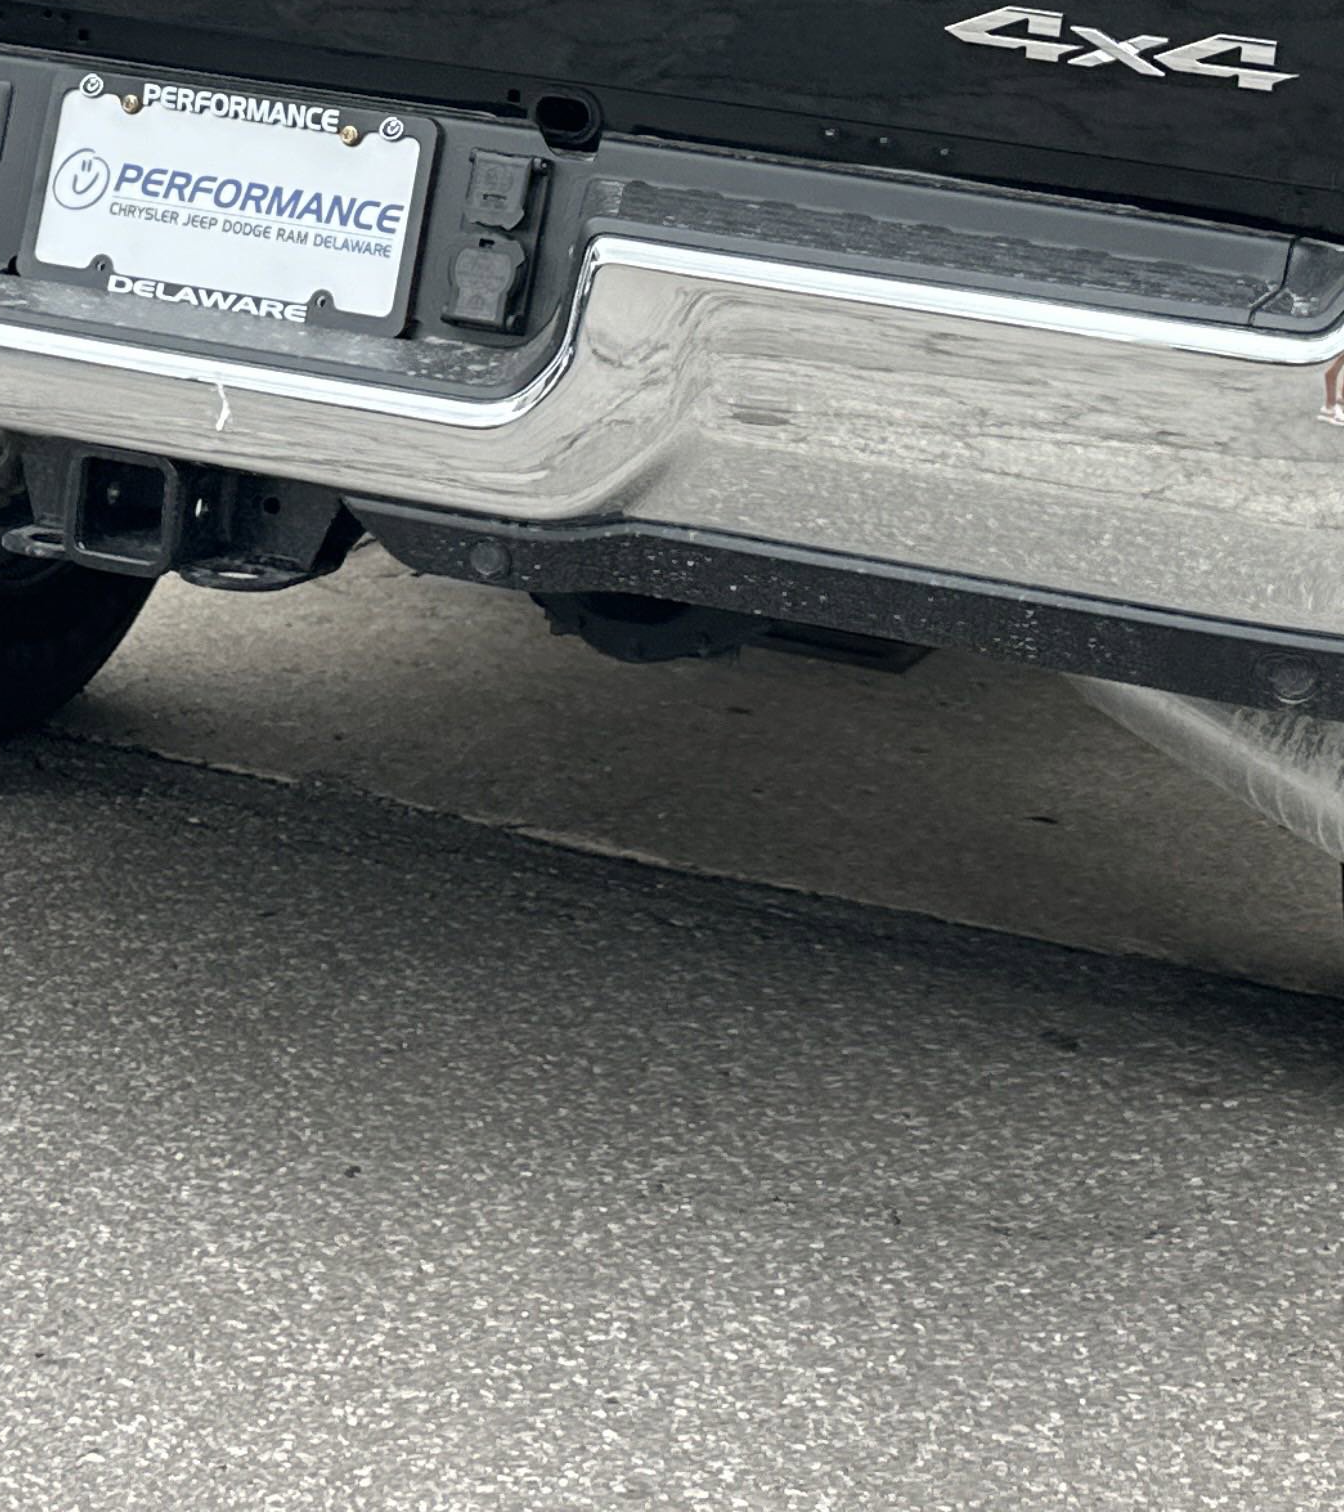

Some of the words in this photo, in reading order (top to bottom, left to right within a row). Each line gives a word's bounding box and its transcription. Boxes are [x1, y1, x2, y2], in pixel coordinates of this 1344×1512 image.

[142, 82, 340, 133] PERFORMANCE
[114, 162, 405, 235] PERFORMANCE
[109, 201, 179, 226] CHRYSLER
[182, 212, 219, 231] JEEP
[222, 218, 272, 240] DODGE
[276, 227, 309, 246] RAM
[314, 232, 393, 259] DELAWARE
[107, 274, 309, 324] DELAWARE
